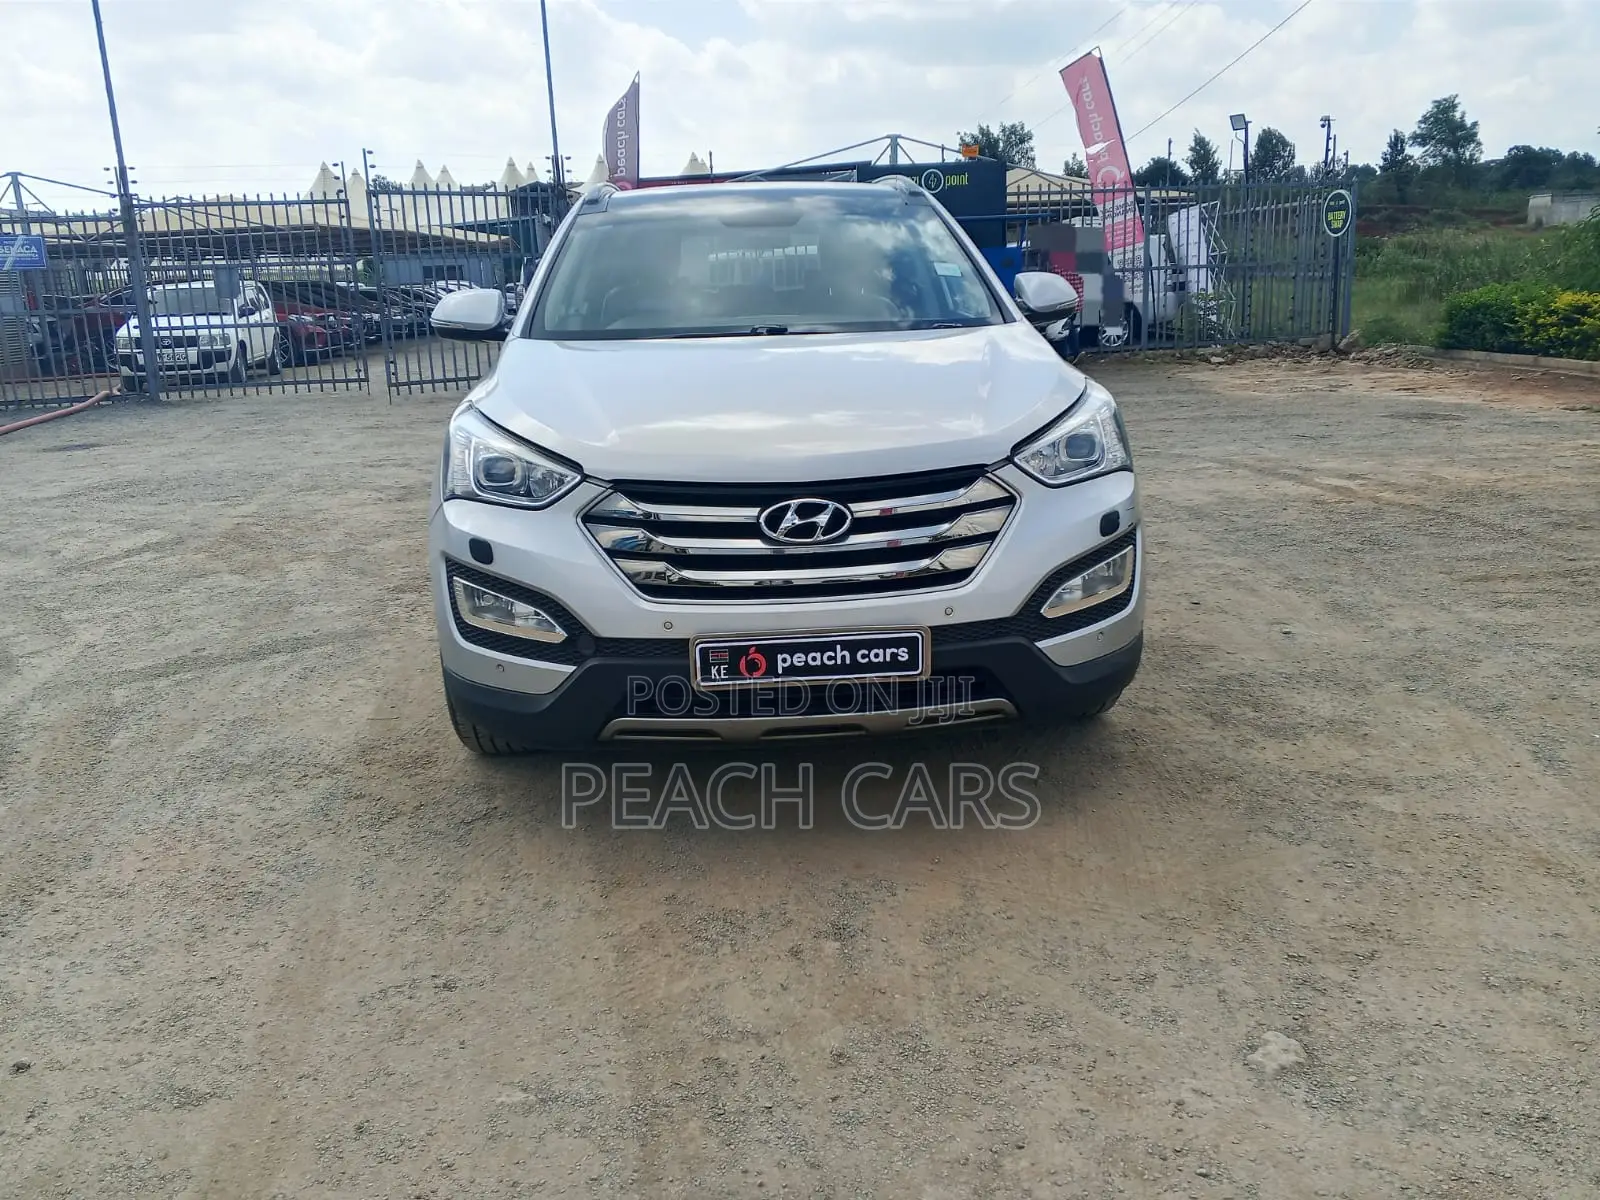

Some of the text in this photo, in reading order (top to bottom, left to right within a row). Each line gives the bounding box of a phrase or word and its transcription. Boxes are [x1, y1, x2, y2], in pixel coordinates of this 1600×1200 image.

[945, 171, 968, 189] point
[777, 643, 909, 675] peach cars
[711, 664, 729, 680] KE
